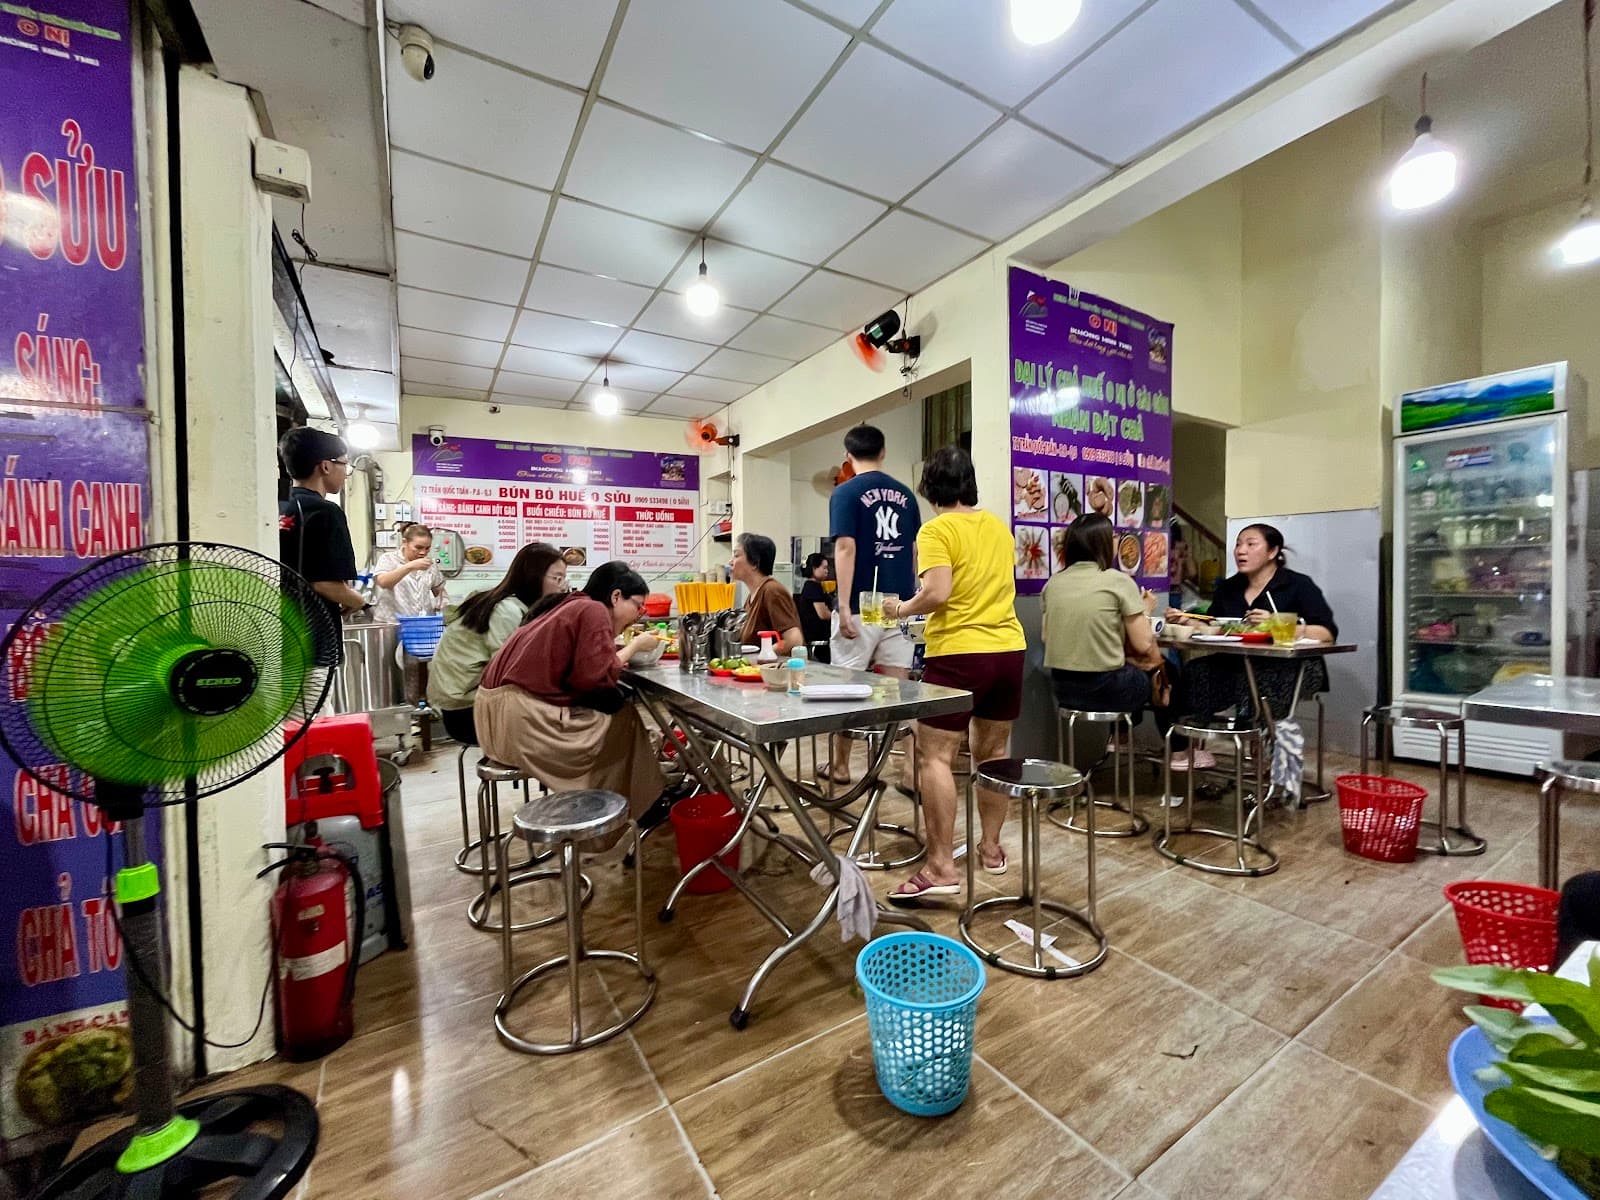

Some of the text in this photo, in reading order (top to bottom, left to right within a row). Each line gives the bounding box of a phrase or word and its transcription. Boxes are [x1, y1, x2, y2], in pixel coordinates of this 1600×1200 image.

[22, 118, 126, 271] SỬU
[1092, 410, 1119, 441] ĐẶT
[1120, 413, 1144, 442] CHẢ
[0, 455, 143, 557] ÁNH CANH
[499, 486, 530, 499] BÚN
[604, 490, 631, 504] SỬU
[860, 488, 908, 508] NEW YORK
[18, 871, 81, 987] CHẢ
